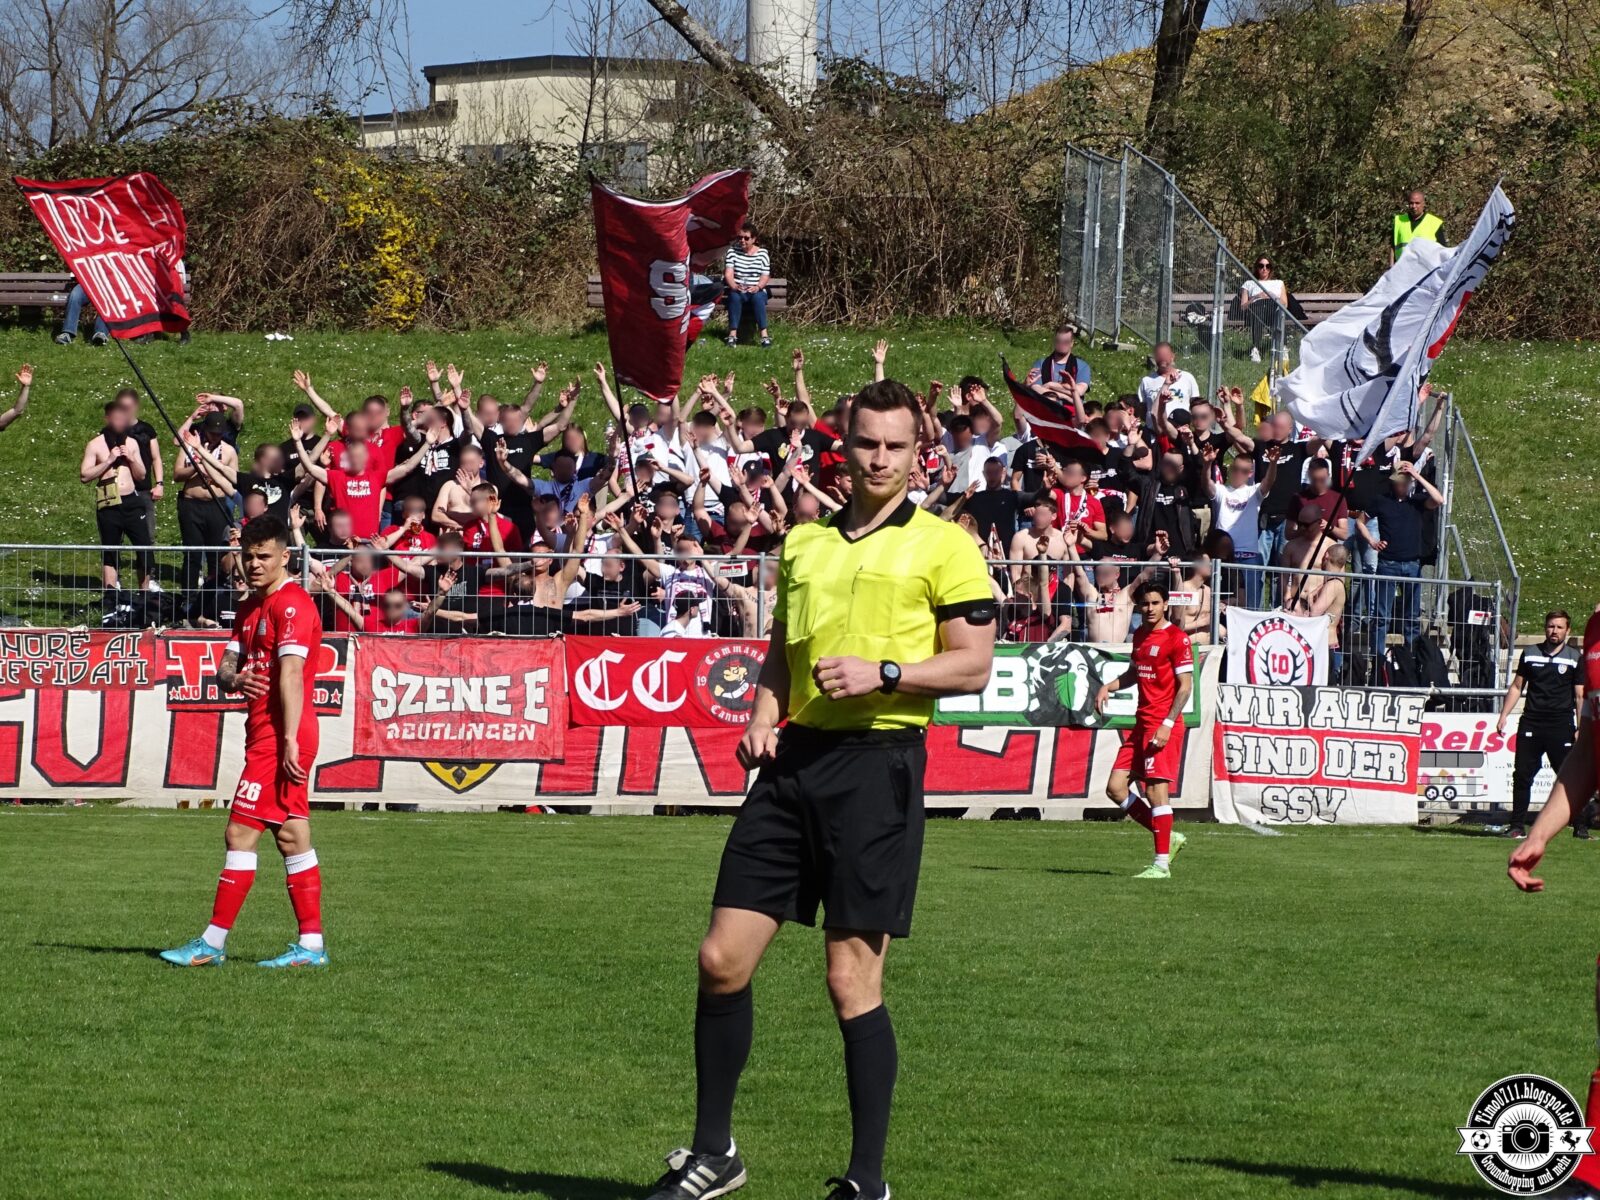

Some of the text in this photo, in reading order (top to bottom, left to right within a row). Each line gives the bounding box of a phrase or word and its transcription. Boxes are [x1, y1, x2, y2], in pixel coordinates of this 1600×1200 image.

[104, 633, 142, 659] AI
[705, 645, 764, 665] Command
[179, 685, 201, 700] NO
[371, 665, 549, 725] SZENE E
[1217, 685, 1427, 735] WIR ALLE
[386, 722, 536, 741] REUTLINGEN
[1224, 732, 1319, 777] SIND
[1322, 737, 1407, 784] DER
[237, 780, 262, 801] 26
[1261, 786, 1347, 822] SSV
